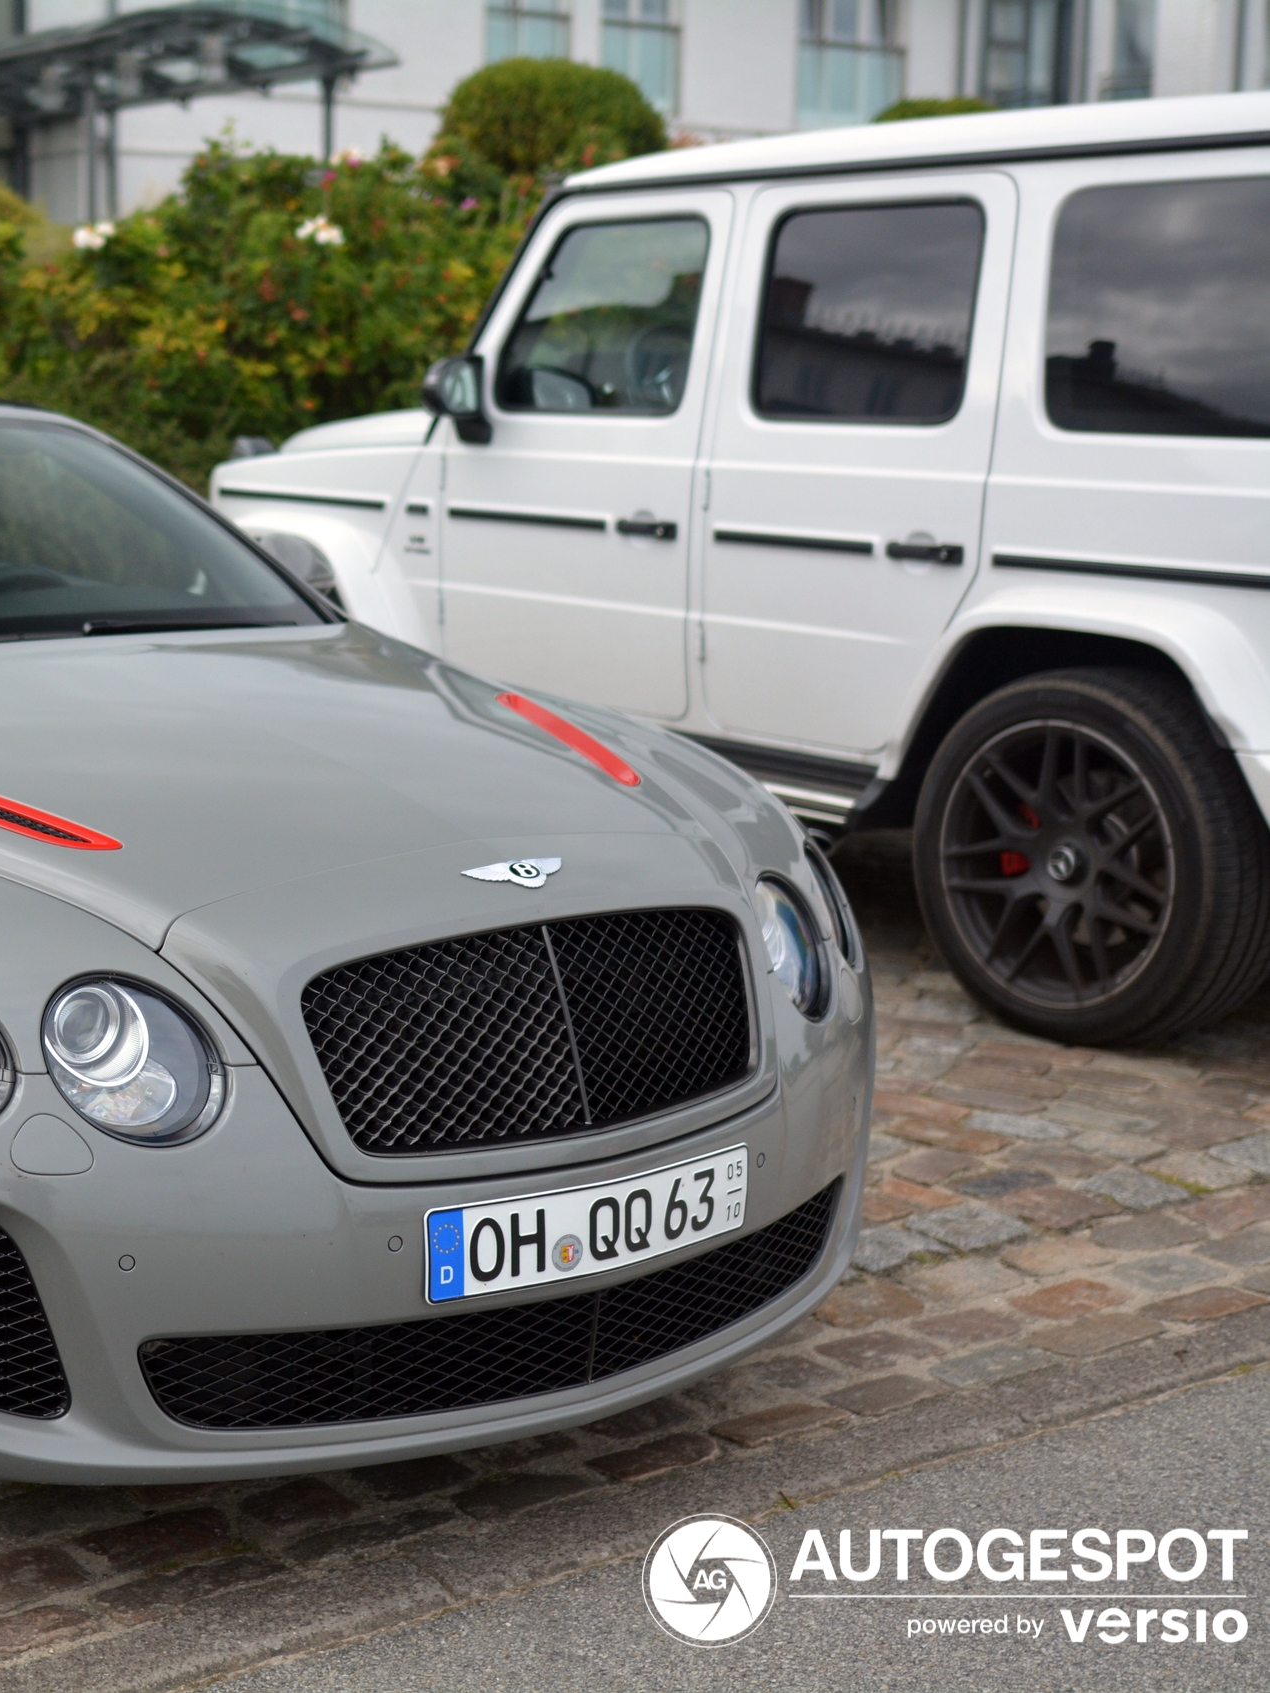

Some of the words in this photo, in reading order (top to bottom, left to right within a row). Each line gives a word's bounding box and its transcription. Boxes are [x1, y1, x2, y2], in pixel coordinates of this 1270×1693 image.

[727, 1160, 743, 1180] 05
[727, 1202, 741, 1221] 10
[440, 1265, 454, 1285] D
[469, 1208, 546, 1282] OH
[589, 1188, 653, 1261] QQ
[664, 1168, 715, 1240] 63
